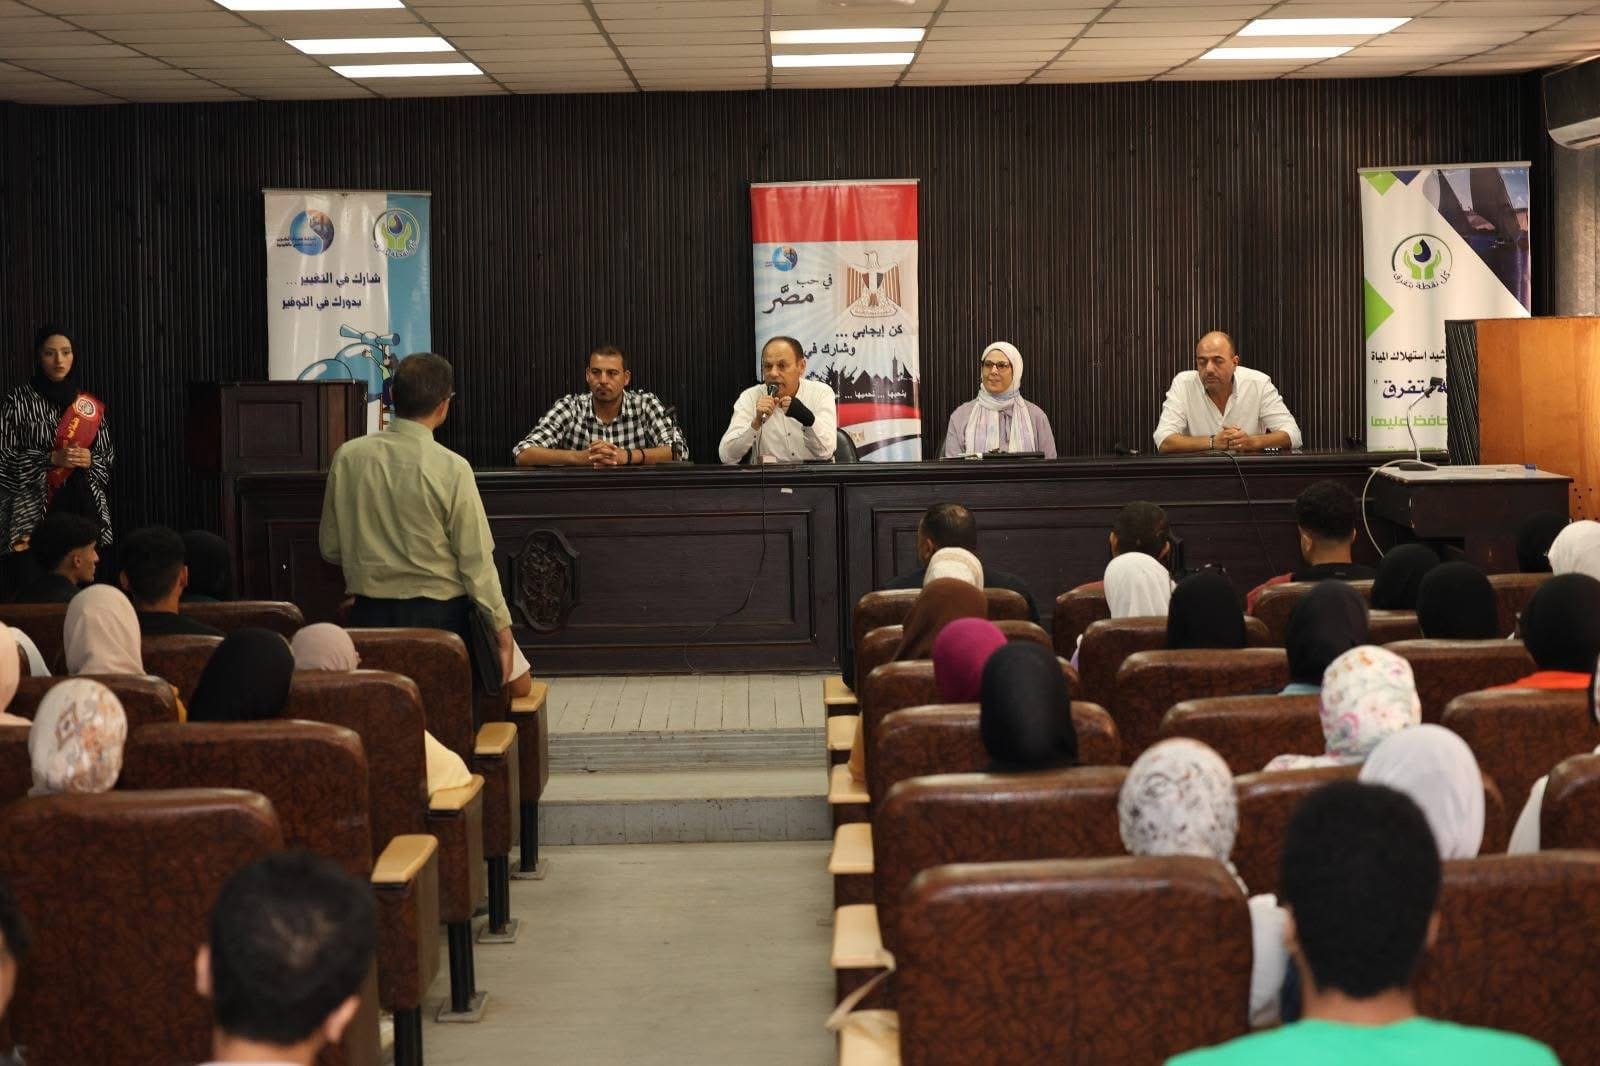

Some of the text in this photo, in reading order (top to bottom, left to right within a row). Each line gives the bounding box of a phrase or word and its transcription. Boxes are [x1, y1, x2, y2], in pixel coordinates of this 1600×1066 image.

[300, 272, 333, 287] التغيير
[335, 273, 350, 288] في
[352, 272, 381, 286] شارك
[797, 273, 833, 290] في حب
[282, 296, 362, 311] بدورك في التوفير
[852, 325, 885, 339] إيجابي
[888, 324, 903, 337] كن
[803, 342, 856, 360] وشارك في
